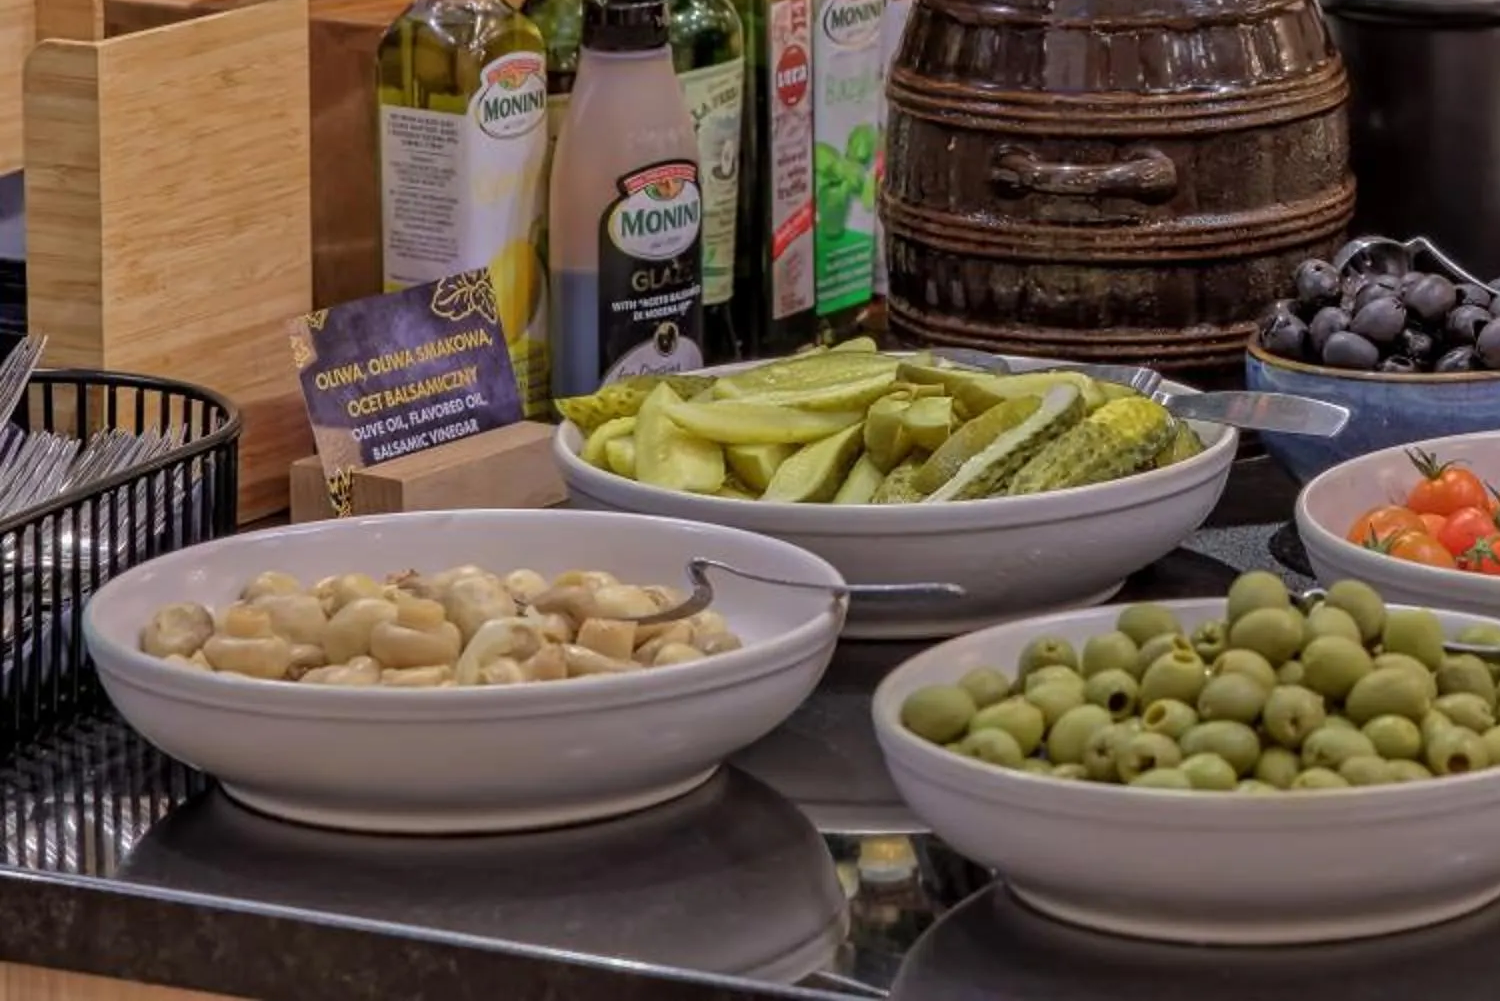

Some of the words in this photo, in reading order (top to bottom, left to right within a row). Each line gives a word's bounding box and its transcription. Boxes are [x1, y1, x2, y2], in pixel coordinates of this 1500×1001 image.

[483, 89, 545, 123] MONINI
[315, 363, 368, 391] OLIWA,
[368, 350, 414, 375] OLIWA
[416, 328, 492, 362] SMAKOWA,
[347, 390, 383, 417] OCET
[384, 366, 478, 406] BALSAMICZNY
[351, 420, 385, 442] OLIVE
[409, 398, 463, 426] FLAVORED
[372, 433, 430, 461] BALSAMIC
[430, 418, 480, 444] VINEGAR
